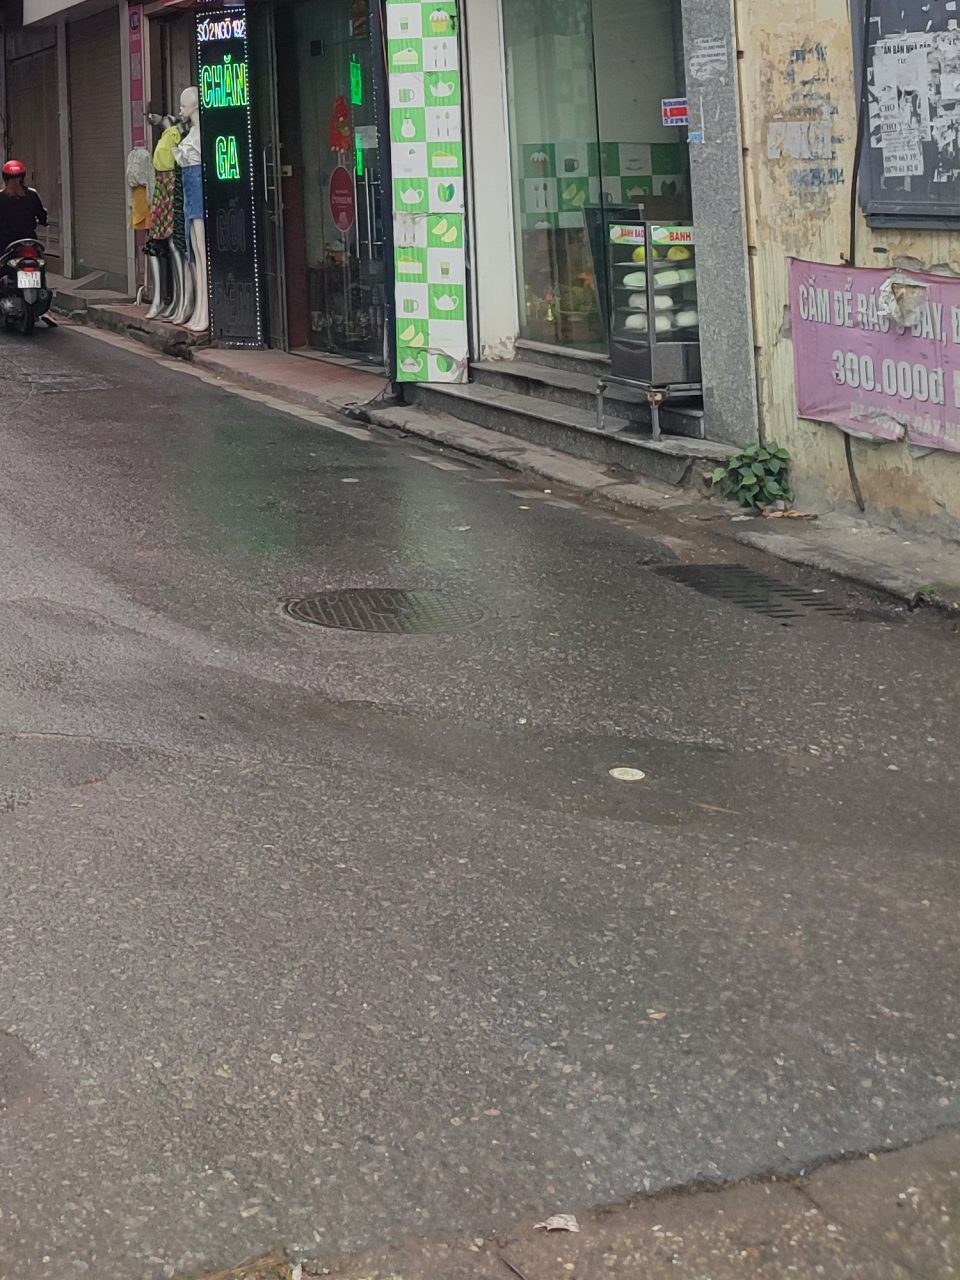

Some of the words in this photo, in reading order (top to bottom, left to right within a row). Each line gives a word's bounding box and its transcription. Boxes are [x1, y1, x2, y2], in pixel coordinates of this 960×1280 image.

[197, 18, 210, 41] SỐ
[209, 23, 215, 40] 2
[215, 18, 232, 39] NGÕ
[232, 20, 245, 38] 192
[200, 53, 248, 109] CHĂN
[215, 136, 241, 180] GA
[834, 277, 855, 328] ĐỂ
